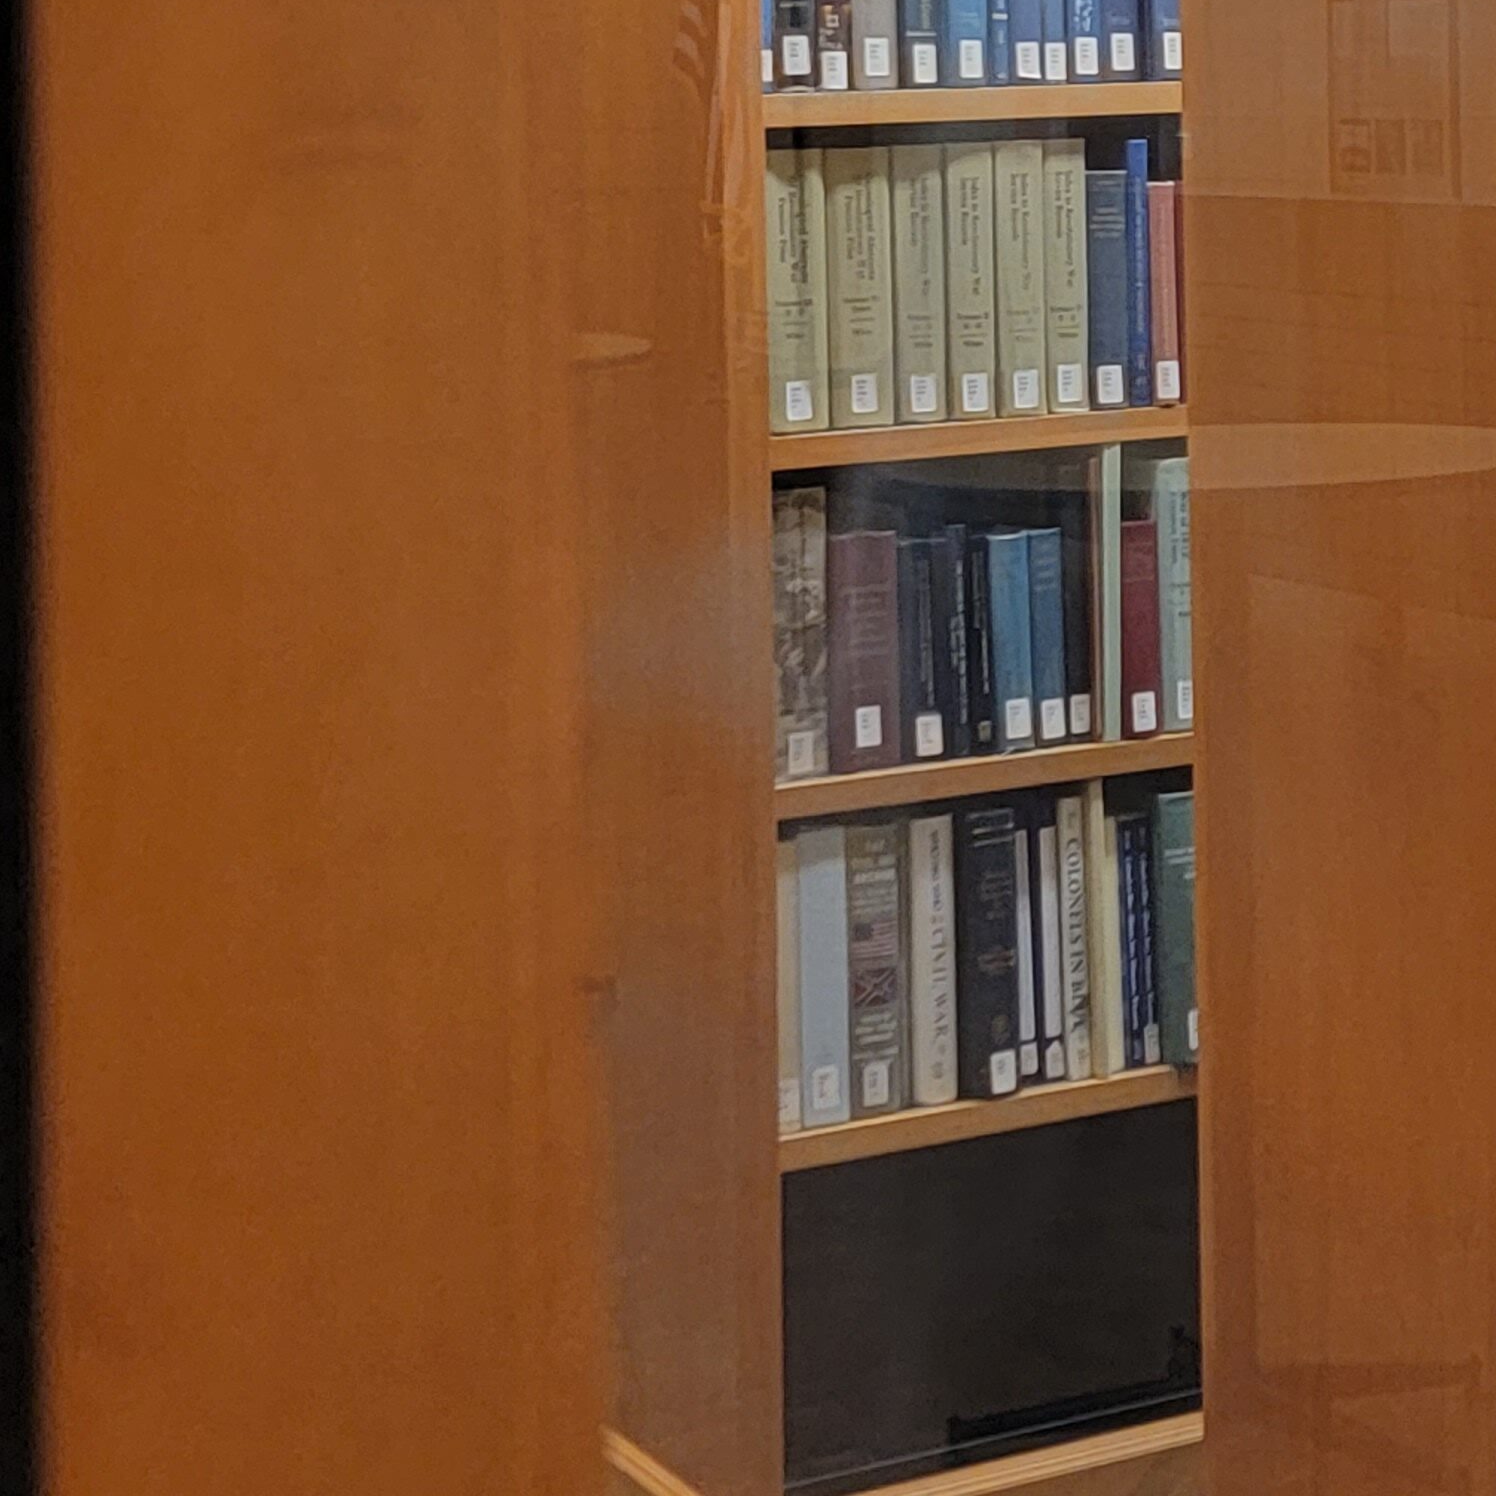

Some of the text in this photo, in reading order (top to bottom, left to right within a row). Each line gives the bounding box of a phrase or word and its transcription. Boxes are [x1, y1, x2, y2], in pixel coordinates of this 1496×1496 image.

[1066, 837, 1084, 946] COLONELS
[1069, 953, 1086, 975] IN
[933, 992, 950, 1040] WAR
